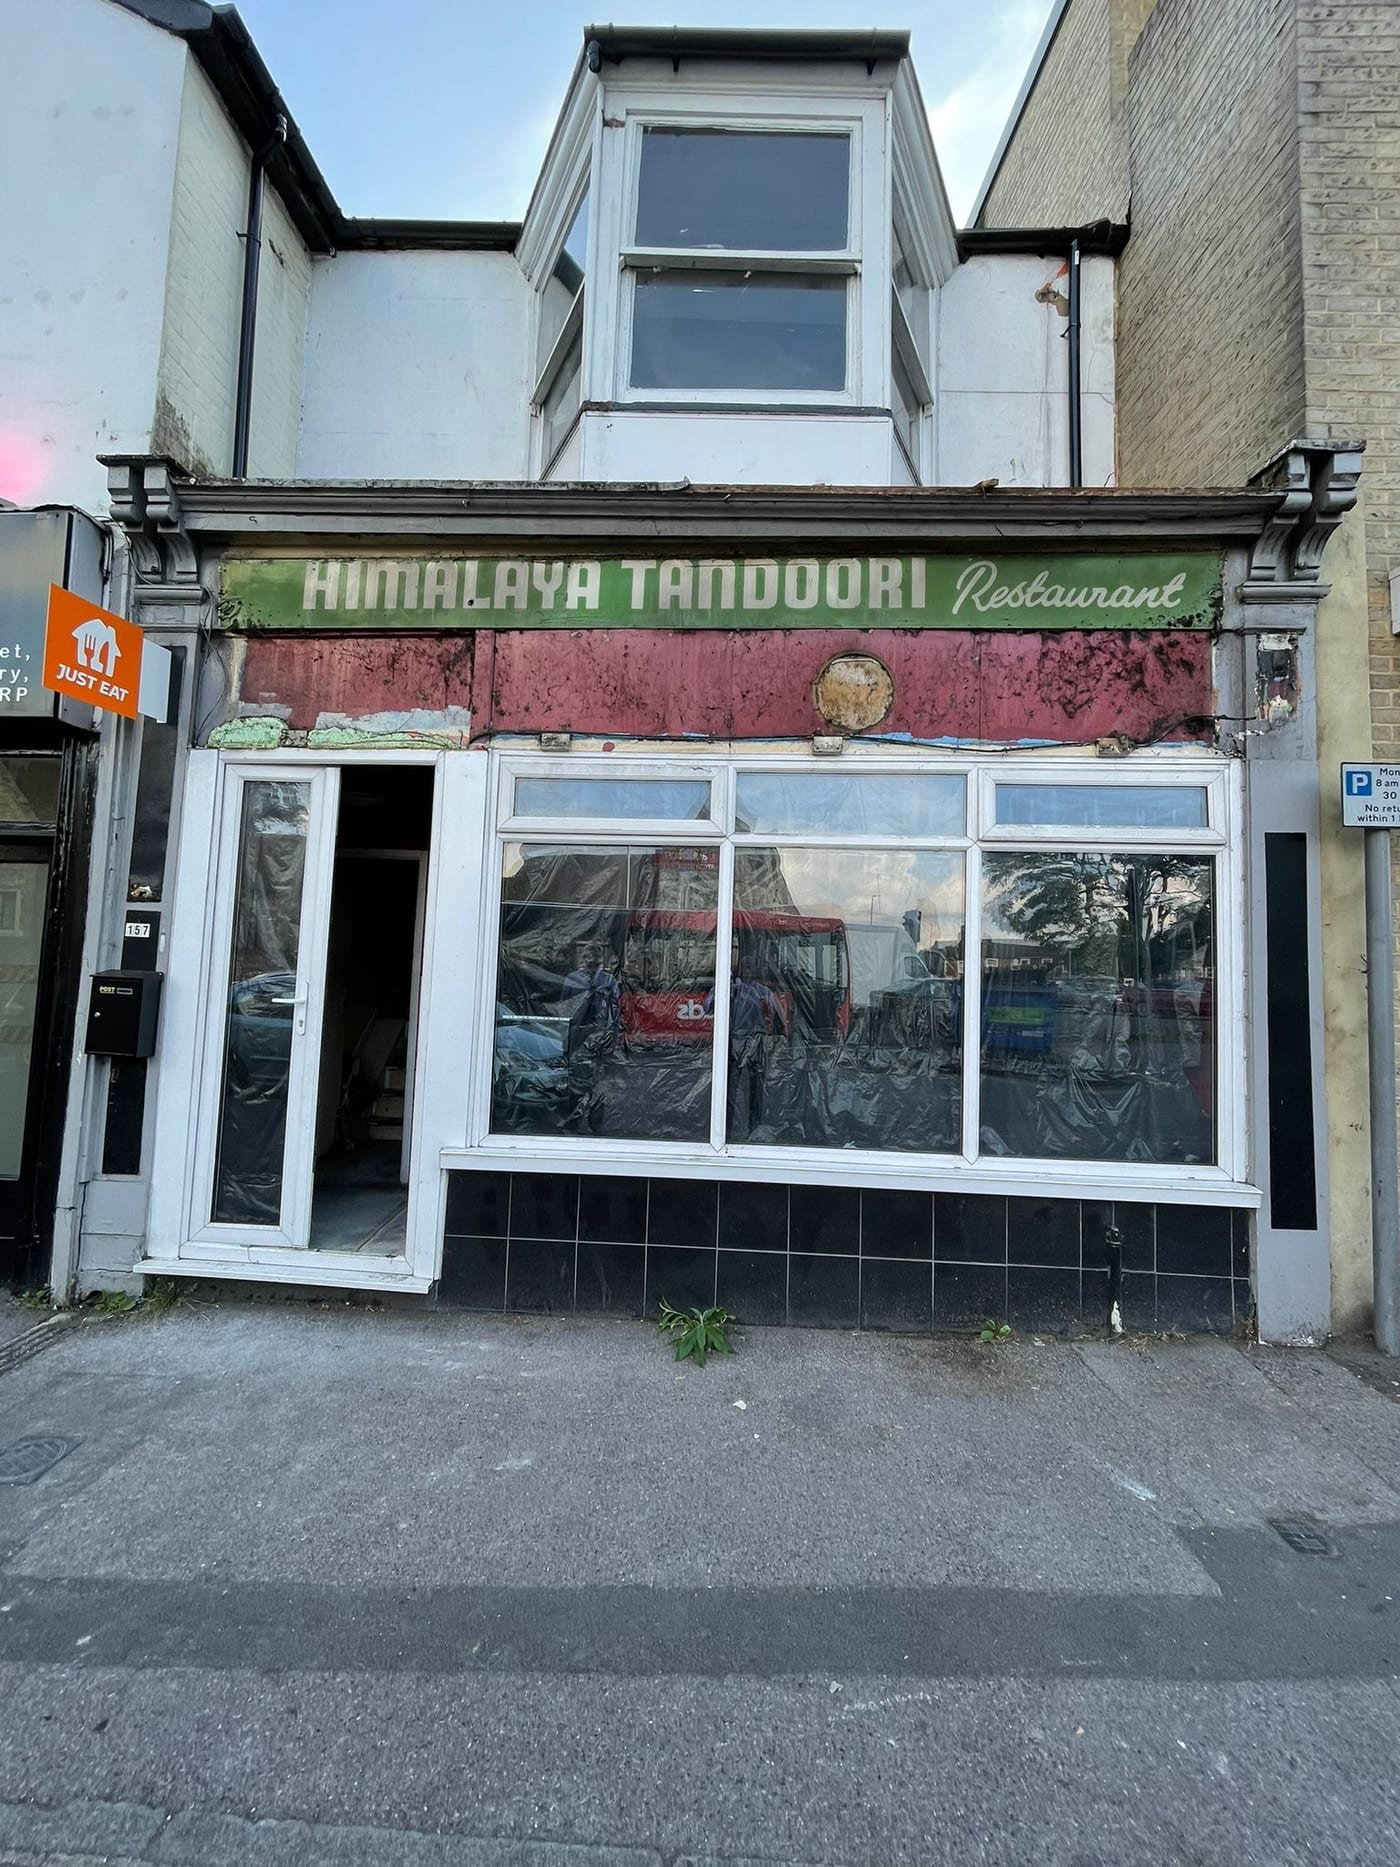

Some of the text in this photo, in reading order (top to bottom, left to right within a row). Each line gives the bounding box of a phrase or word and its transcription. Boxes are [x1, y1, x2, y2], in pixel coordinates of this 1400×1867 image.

[302, 557, 1188, 615] HIMALAYA TANDOORI Restaurant
[56, 663, 129, 702] JUST EAT
[1351, 773, 1369, 794] P
[1376, 778, 1383, 787] 8
[1383, 791, 1397, 800] 30
[1365, 804, 1379, 813] No
[1357, 815, 1388, 823] within
[128, 925, 149, 936] 157
